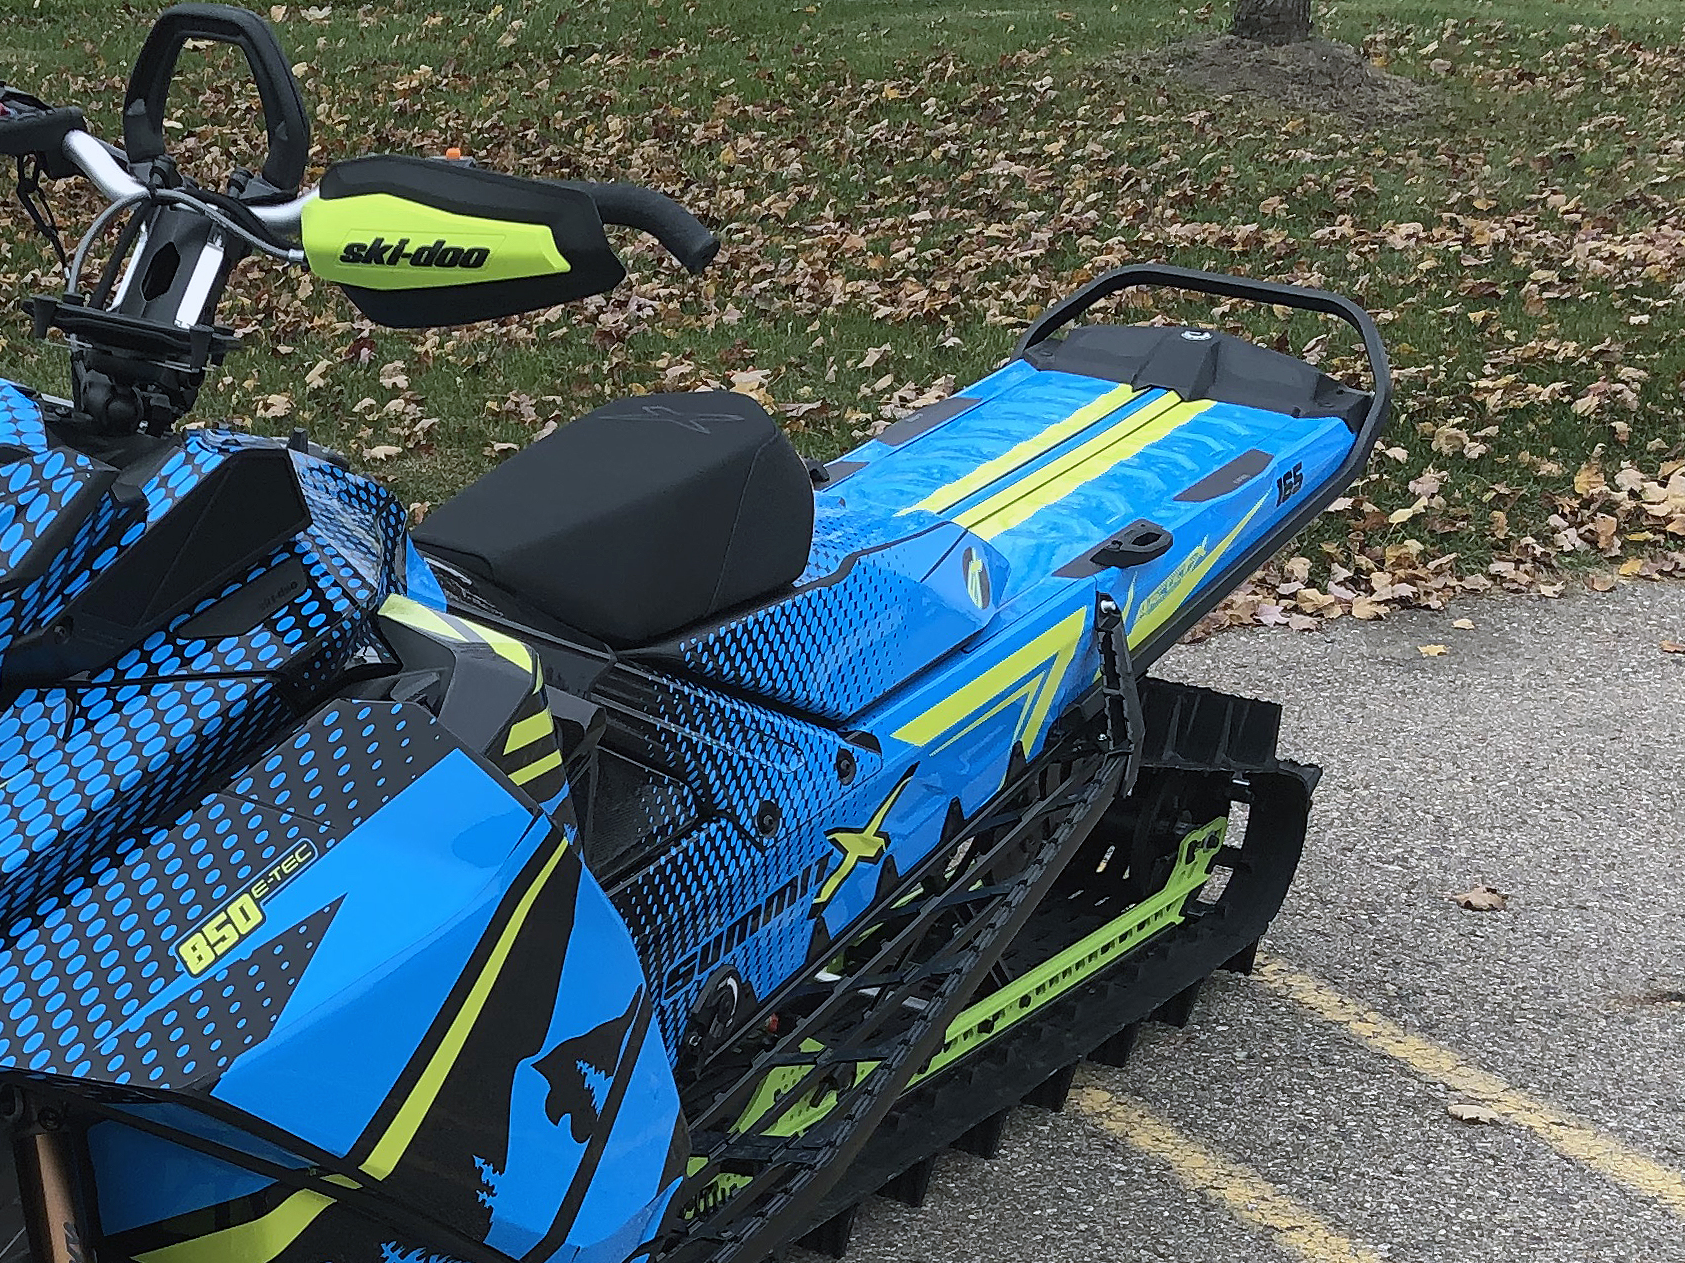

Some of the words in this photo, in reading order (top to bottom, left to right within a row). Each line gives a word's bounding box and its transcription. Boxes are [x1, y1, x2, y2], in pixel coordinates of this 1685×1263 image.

[339, 236, 490, 268] ski-doo
[1276, 461, 1304, 508] 165
[178, 892, 264, 976] 850
[250, 843, 313, 900] E-TEC
